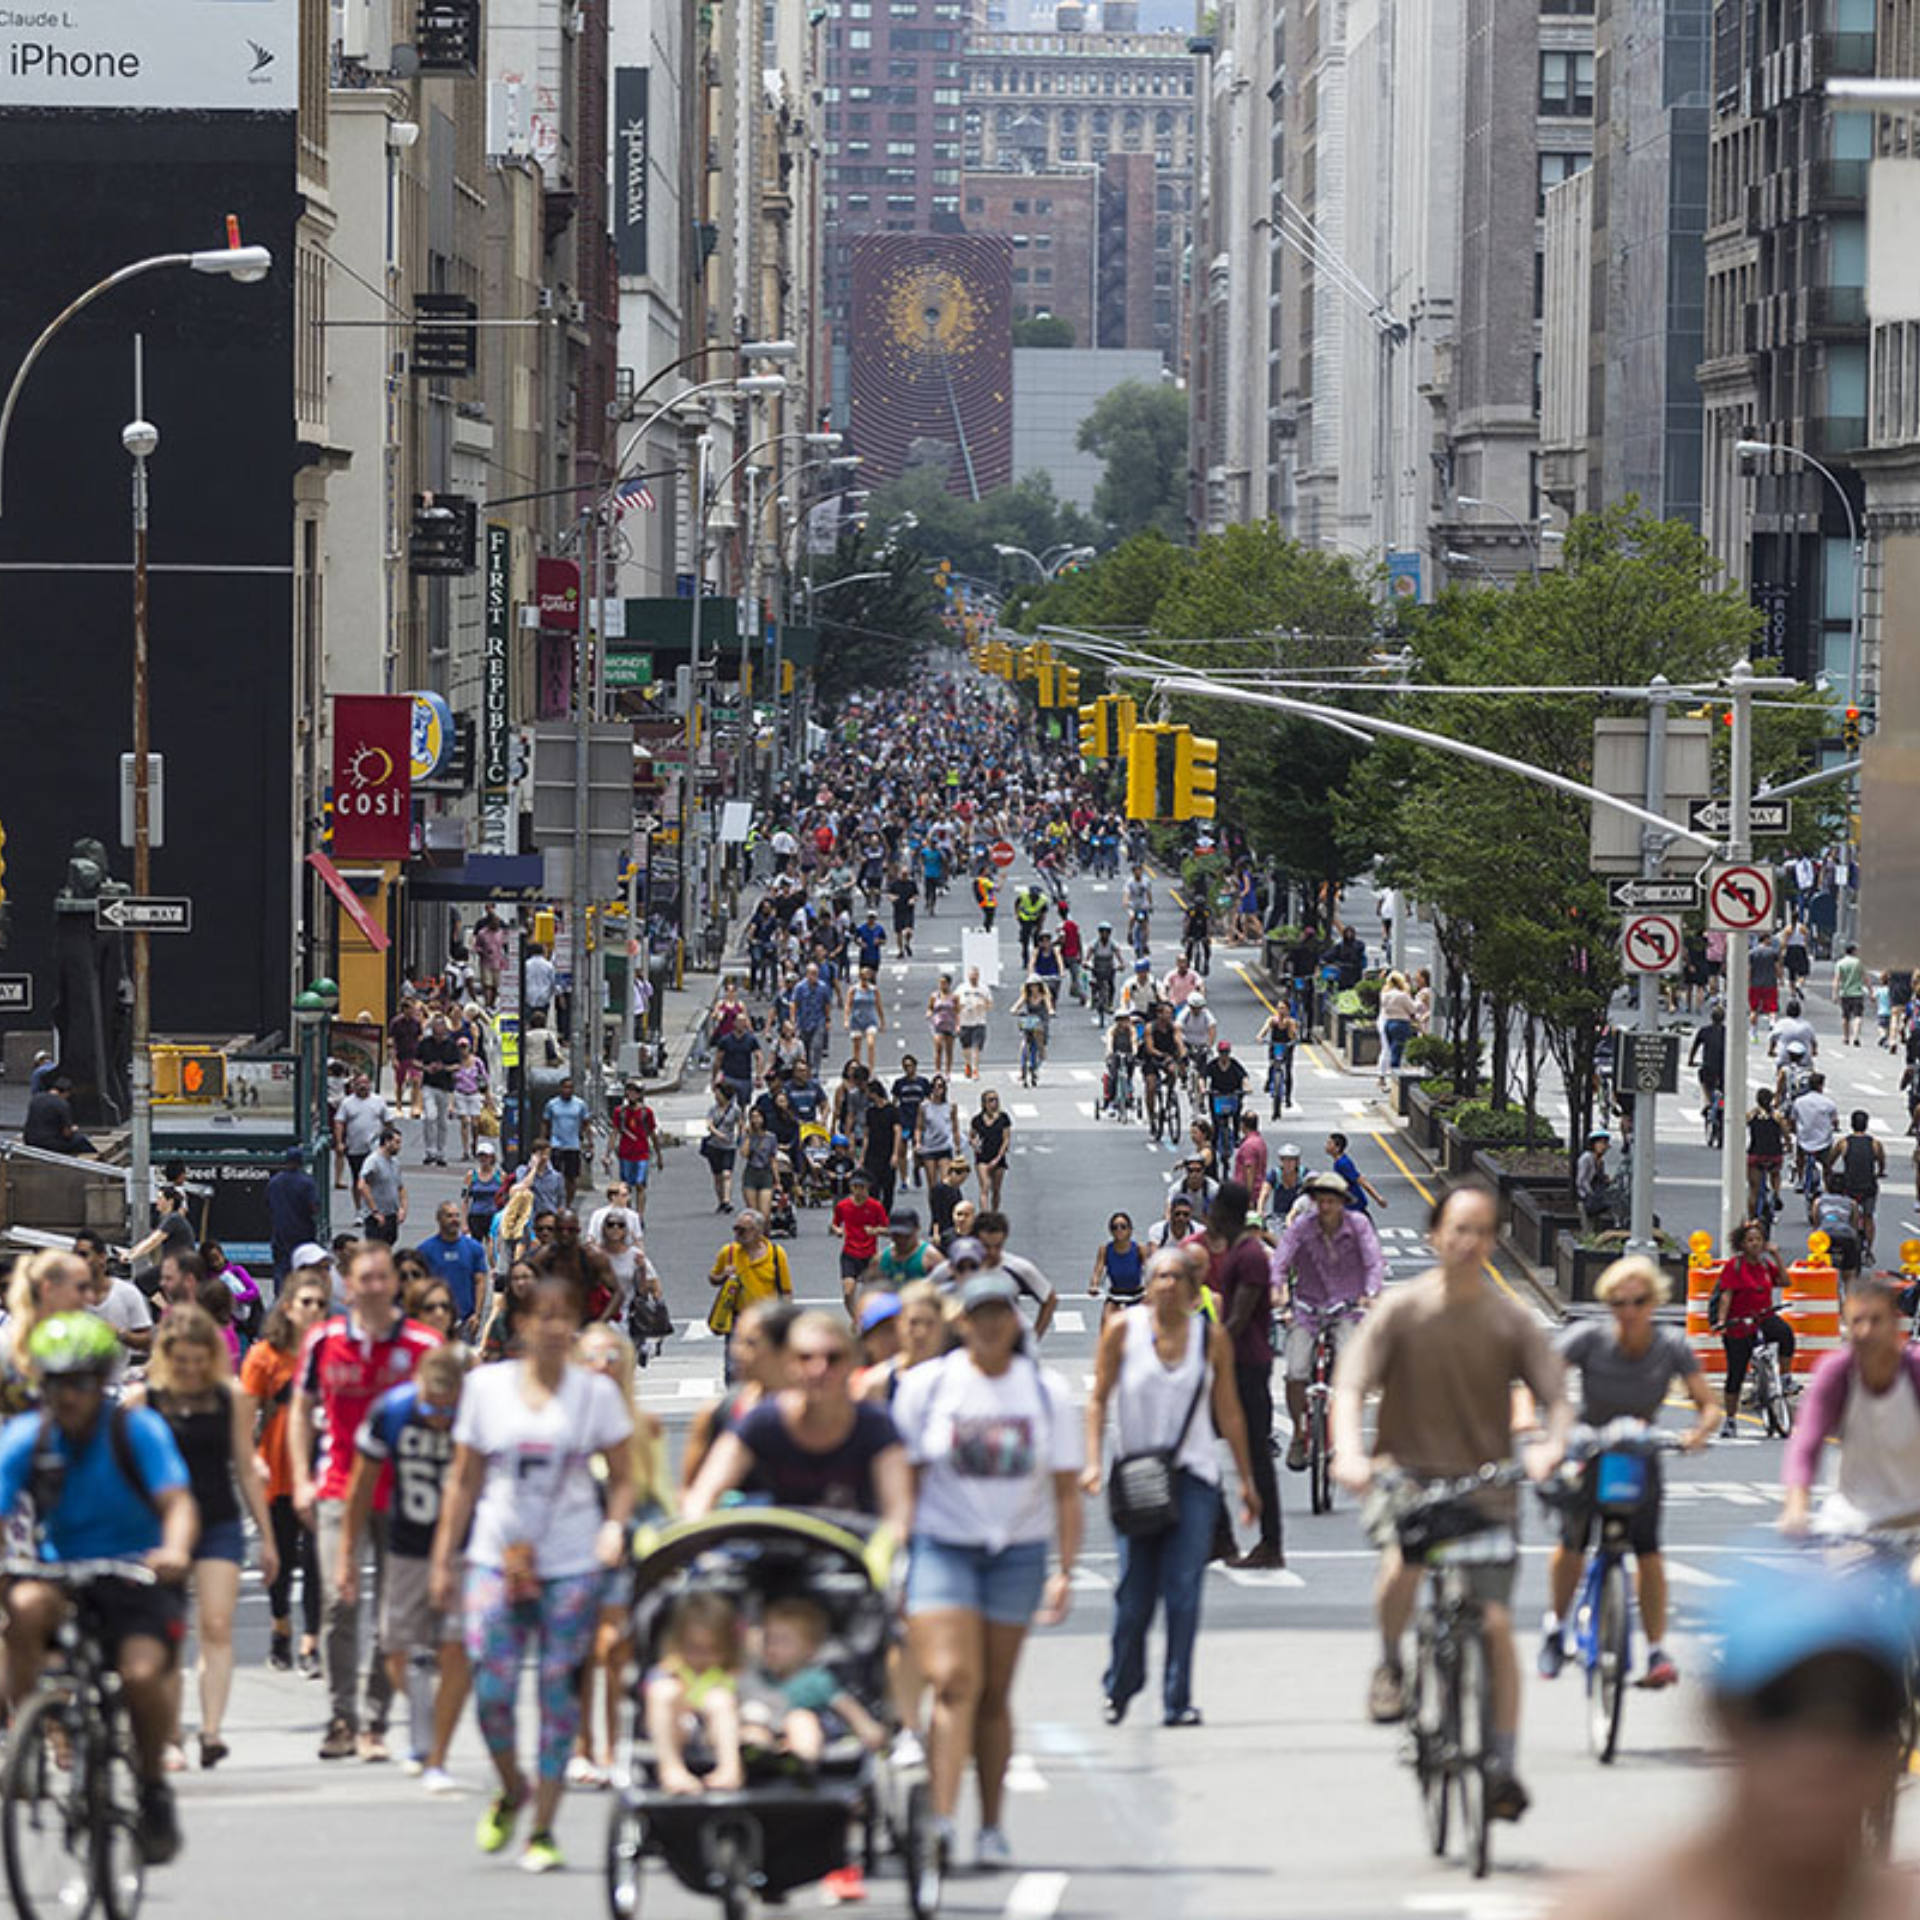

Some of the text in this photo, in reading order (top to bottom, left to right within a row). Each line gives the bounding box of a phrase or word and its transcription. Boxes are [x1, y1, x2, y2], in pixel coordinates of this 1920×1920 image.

[11, 43, 140, 77] iPhone
[620, 118, 644, 225] wework
[487, 532, 505, 782] FIRST REPUBLIC
[1621, 888, 1687, 900] ONE WAY
[111, 907, 177, 920] ONE WAY
[221, 1166, 270, 1181] Station
